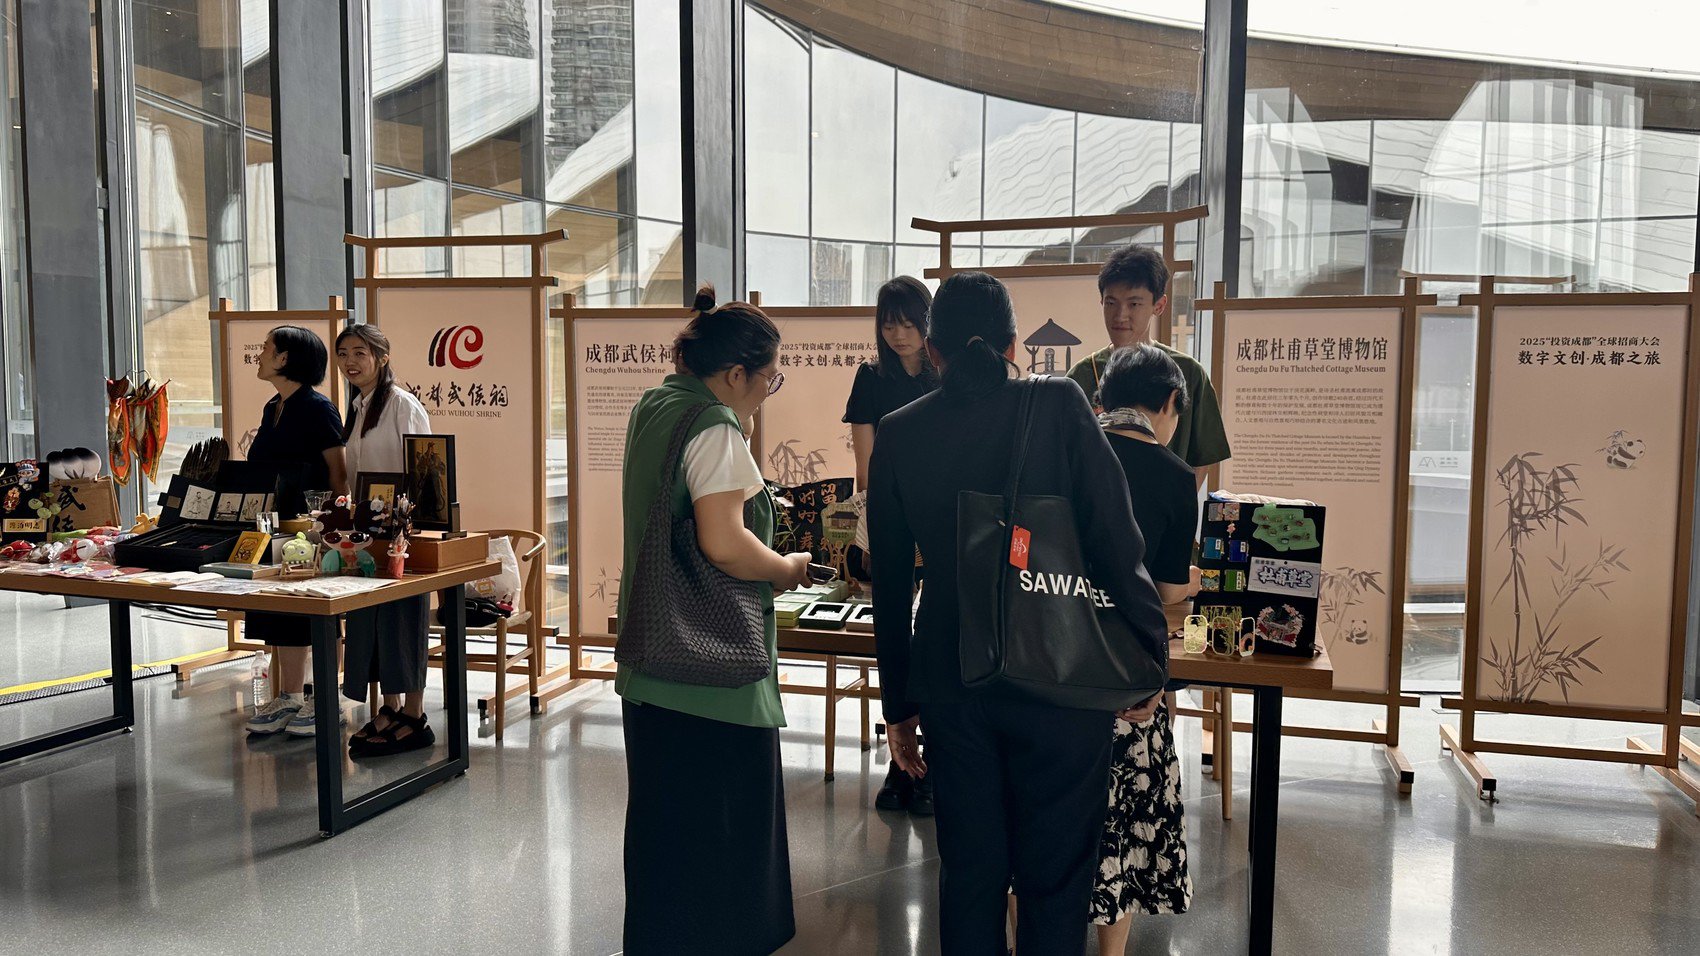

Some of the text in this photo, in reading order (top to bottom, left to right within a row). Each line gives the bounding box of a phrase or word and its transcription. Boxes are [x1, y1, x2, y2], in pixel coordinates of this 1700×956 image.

[1519, 336, 1661, 347] 2025“投资成都”全球招商大会
[585, 343, 675, 364] 成都武侯祠
[1236, 337, 1388, 361] 成都杜甫草堂博物馆
[1518, 350, 1662, 366] 数字文创·成都之旅
[585, 366, 666, 375] Chengdu Wuhou Shrine
[1236, 365, 1386, 375] Chengdu Du Fu Thatched Cottage Museum
[448, 410, 475, 418] WUHOU
[476, 410, 502, 418] SHRINE
